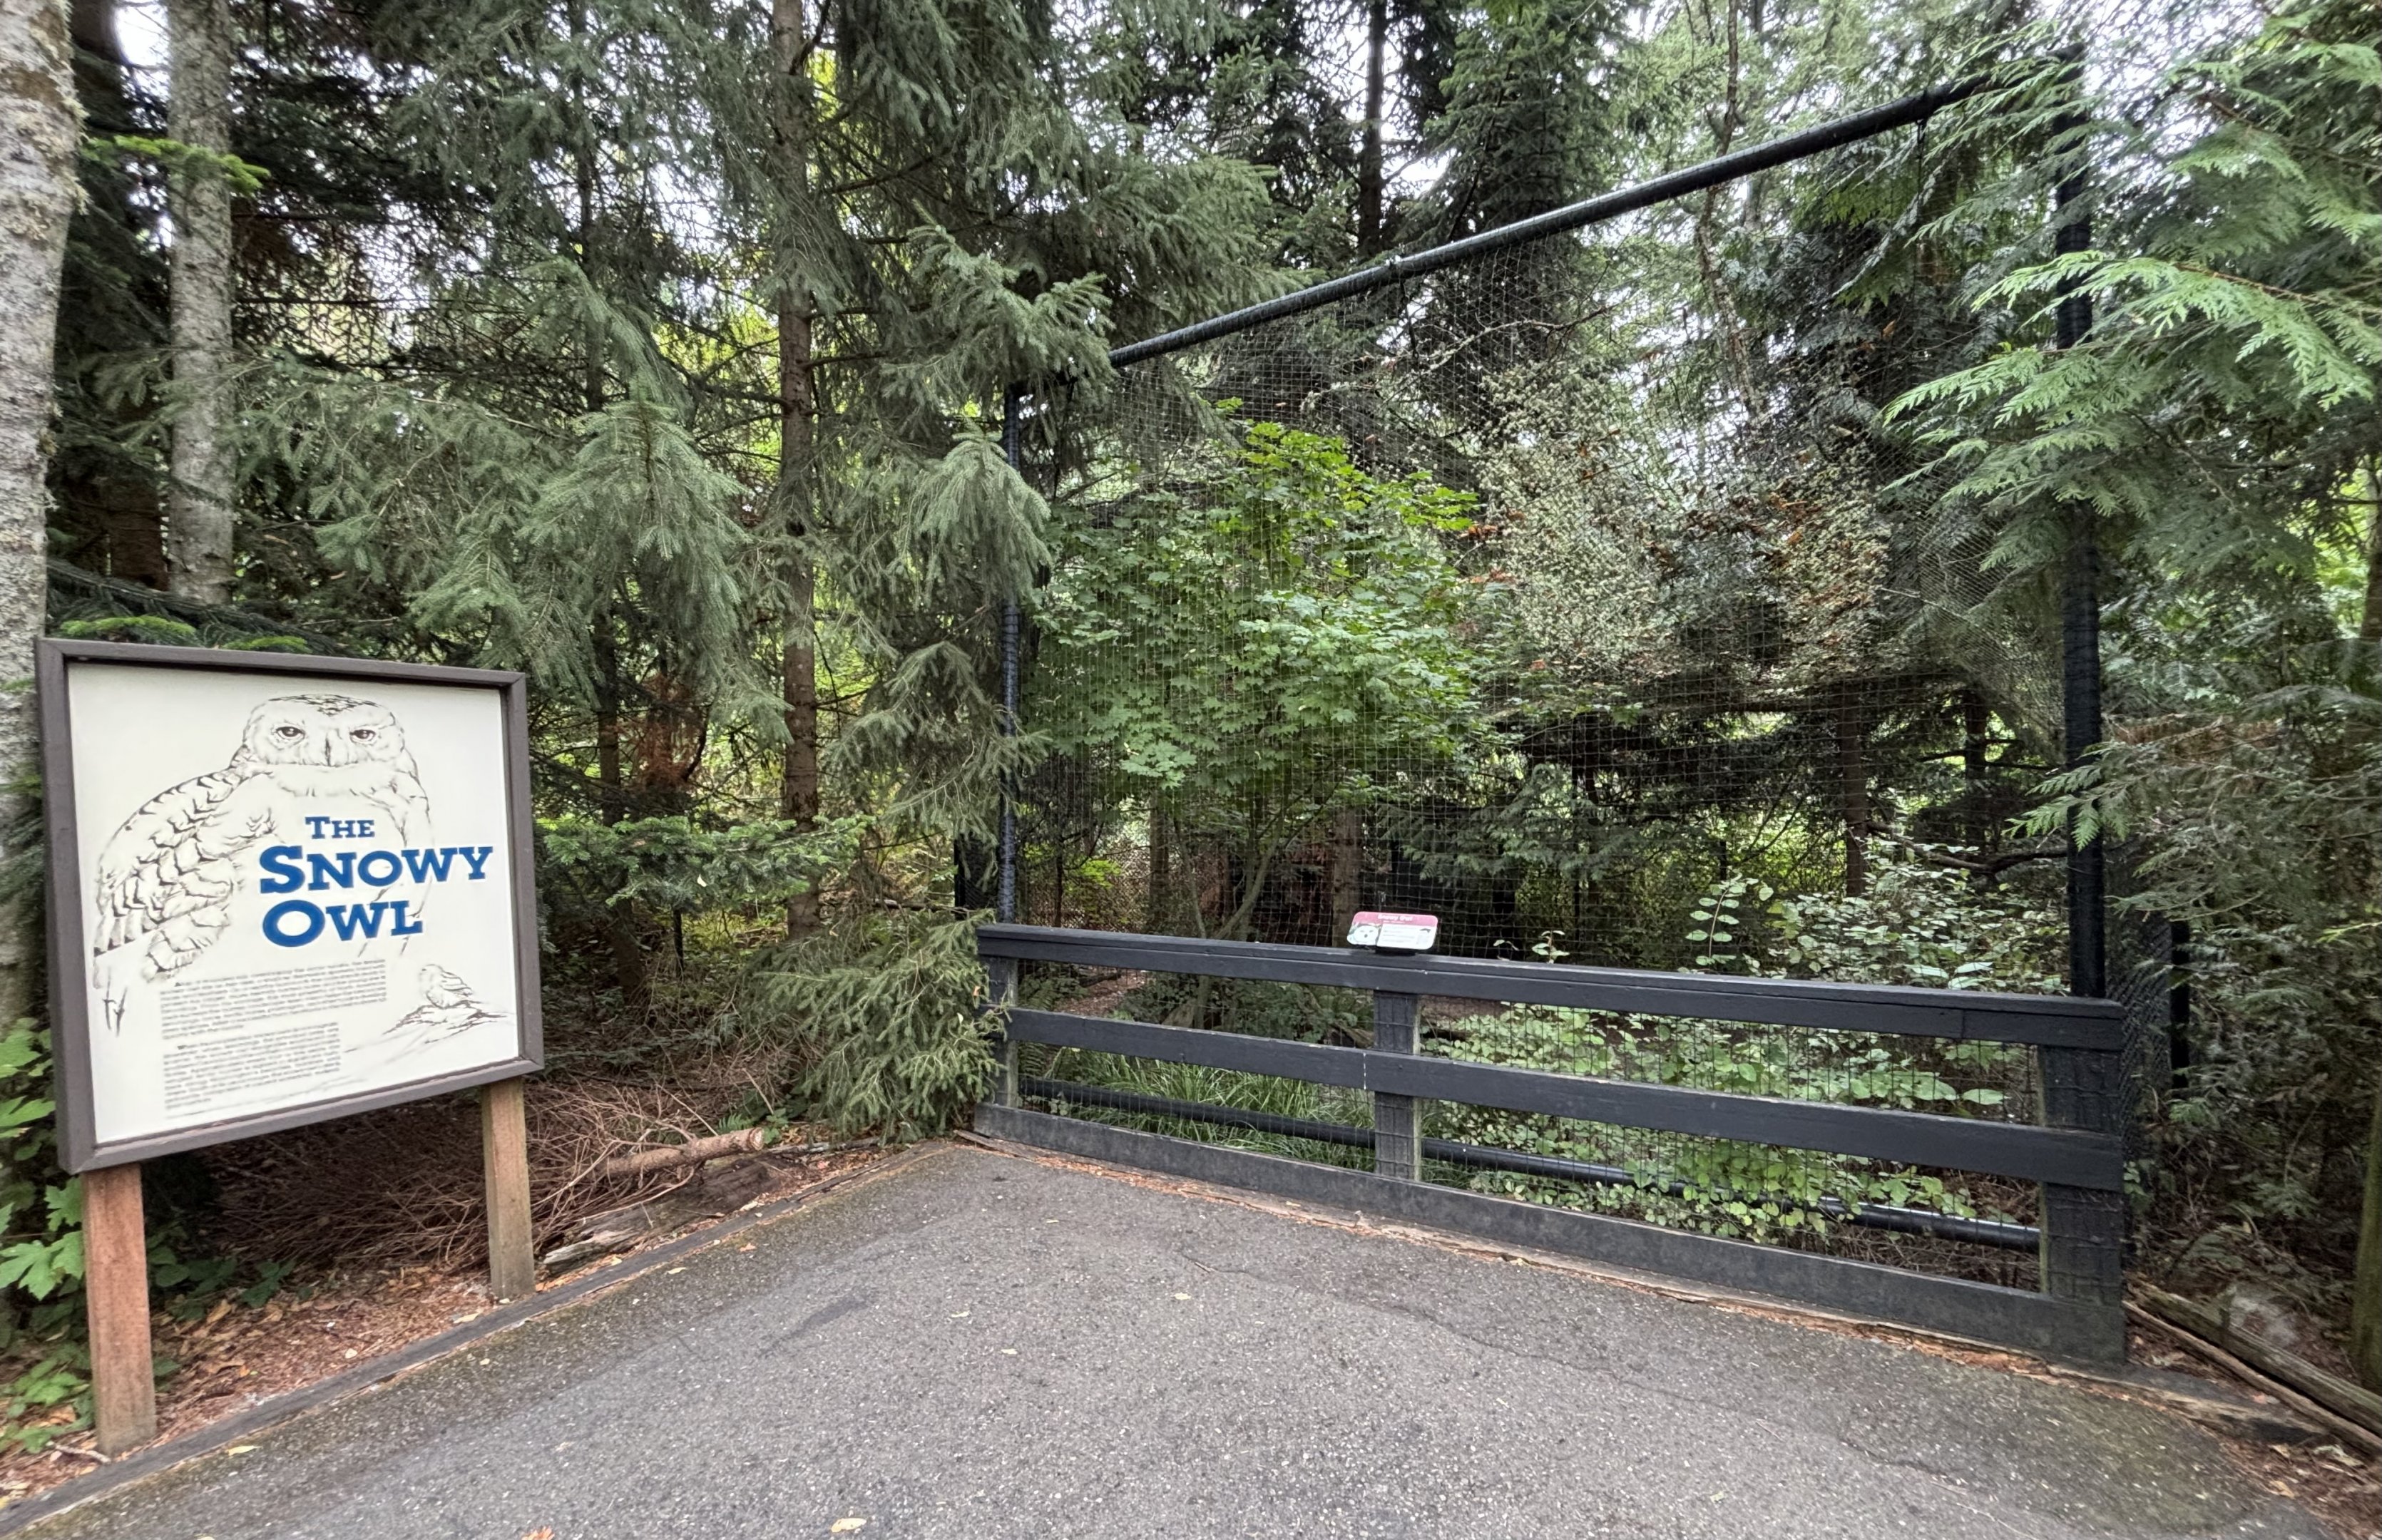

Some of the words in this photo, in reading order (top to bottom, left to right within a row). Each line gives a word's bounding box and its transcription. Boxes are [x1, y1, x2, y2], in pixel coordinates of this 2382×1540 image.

[305, 816, 375, 839] THE
[259, 845, 494, 894] SNOWY
[262, 899, 424, 948] OWL
